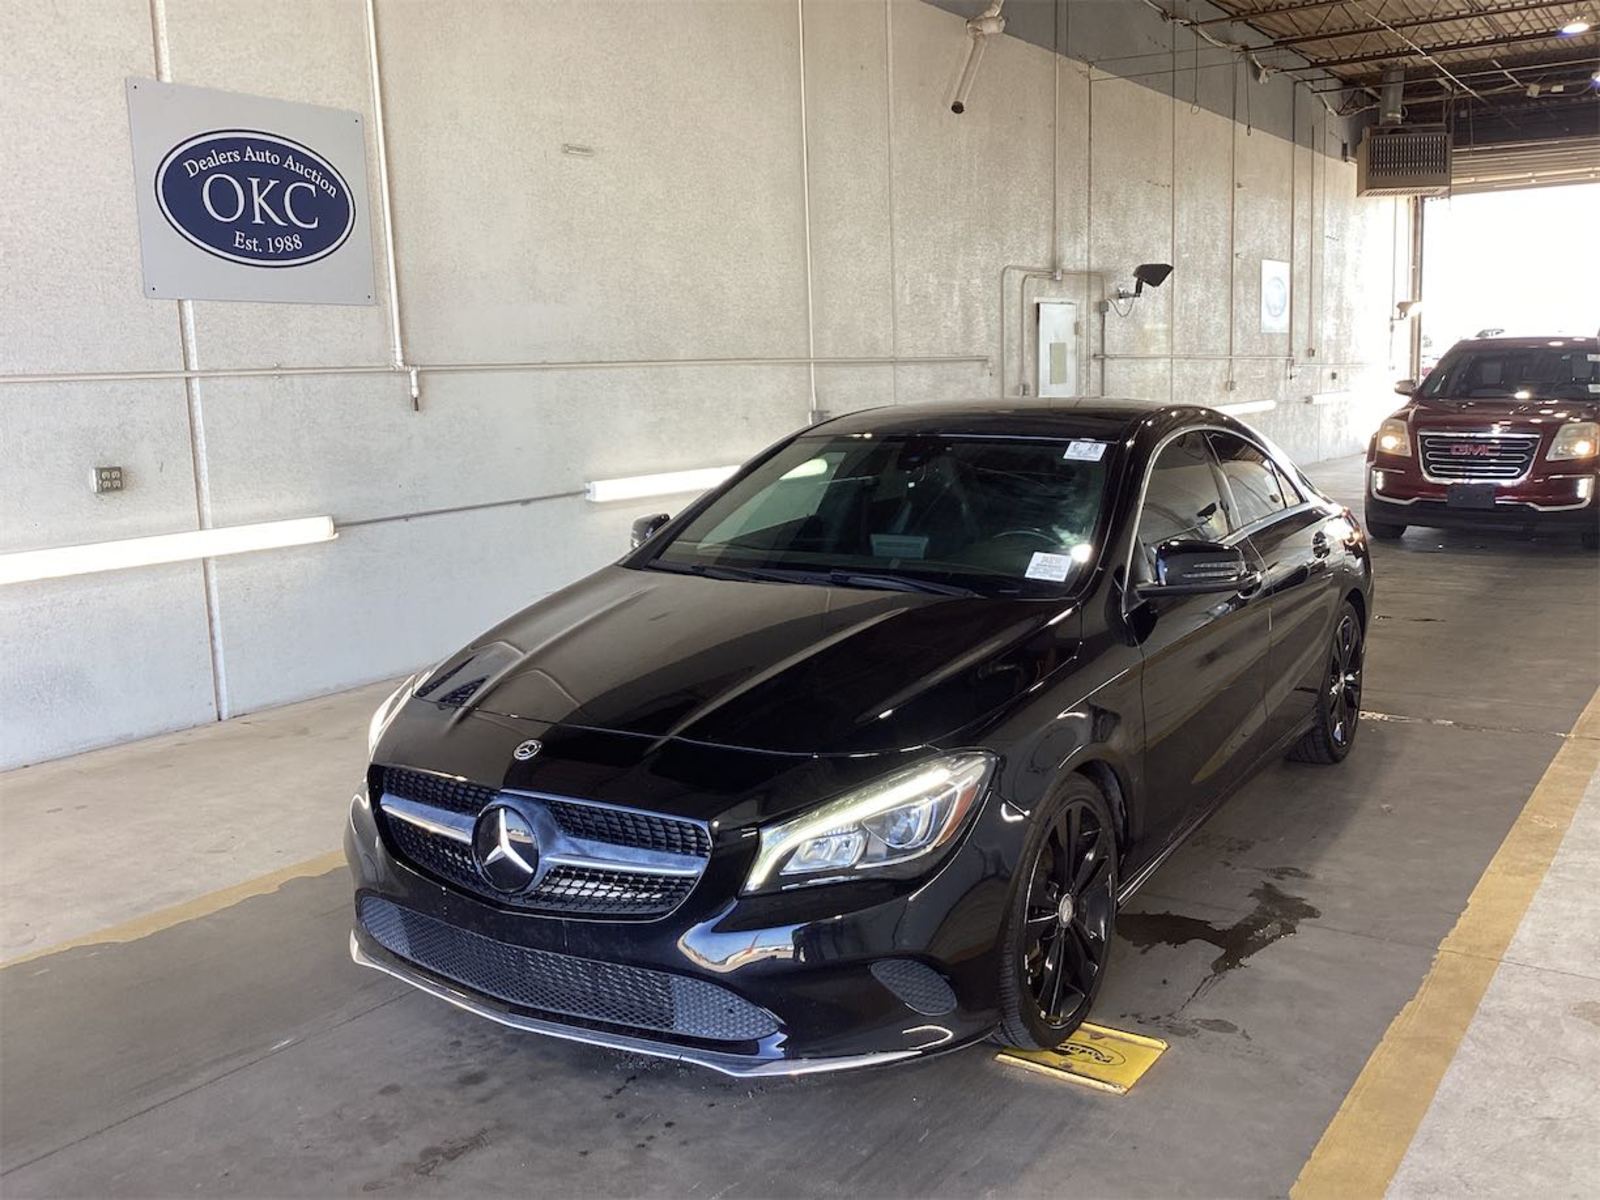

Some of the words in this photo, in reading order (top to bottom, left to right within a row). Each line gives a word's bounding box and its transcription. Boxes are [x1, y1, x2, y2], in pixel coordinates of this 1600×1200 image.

[183, 150, 241, 178] Dealers
[243, 146, 280, 165] Auto
[283, 154, 338, 198] Auction
[202, 173, 319, 229] OKC
[233, 231, 262, 252] Est.
[267, 233, 303, 253] 1988
[1450, 444, 1501, 456] GMC
